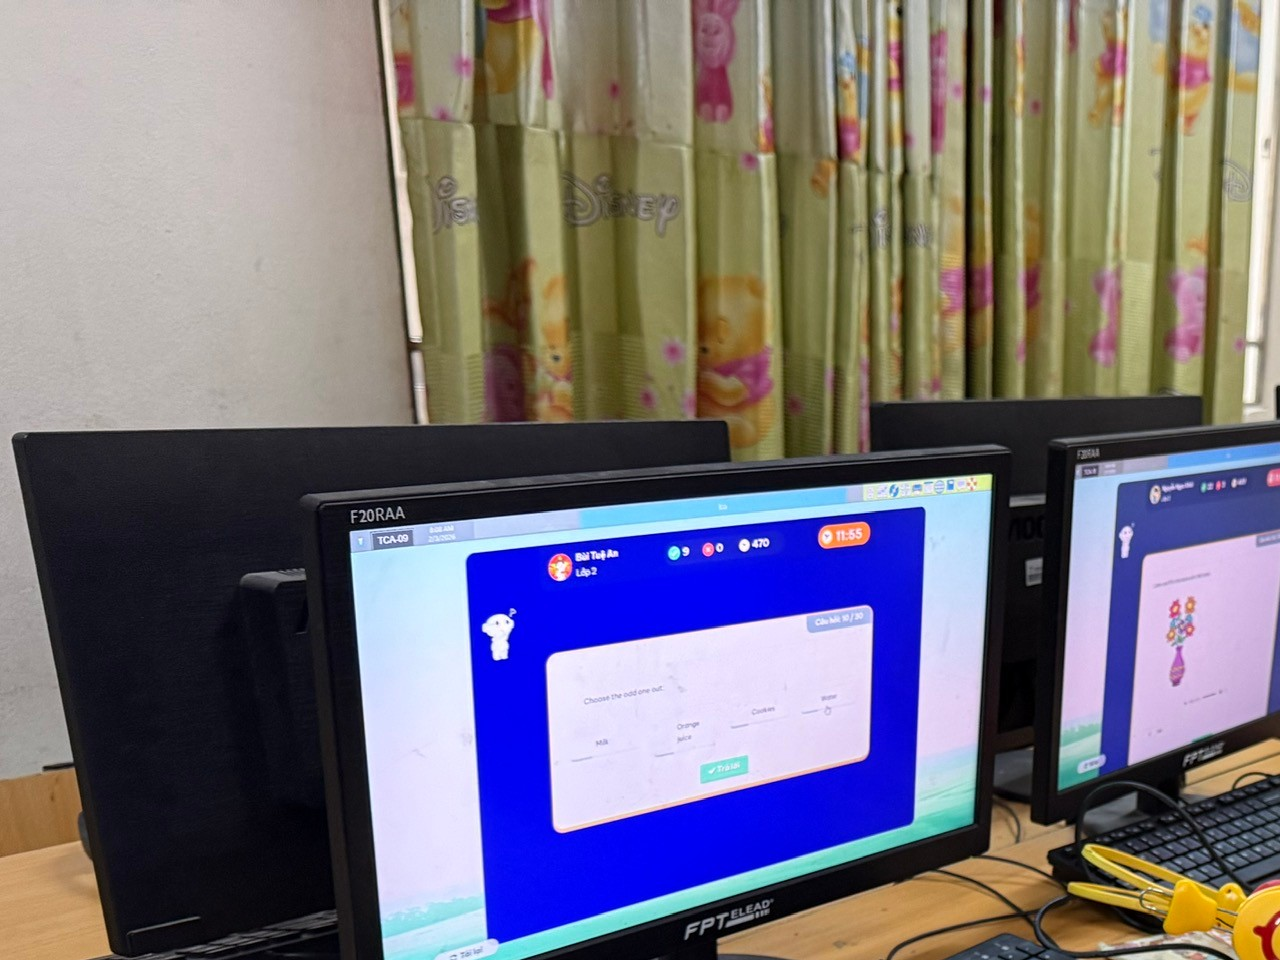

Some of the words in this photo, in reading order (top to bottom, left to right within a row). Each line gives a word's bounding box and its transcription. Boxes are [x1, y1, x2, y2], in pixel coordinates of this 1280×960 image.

[350, 506, 405, 523] F20RAA
[377, 534, 409, 545] TCA-09
[836, 528, 863, 542] 11:55
[715, 542, 724, 552] 0
[752, 538, 770, 548] 470
[606, 549, 619, 558] An
[682, 547, 690, 556] 9
[590, 566, 598, 576] 2
[584, 696, 610, 705] Choose
[623, 689, 637, 698] odd
[752, 706, 775, 716] Cookies
[677, 720, 700, 731] Orange
[684, 911, 730, 940] FPT
[730, 900, 772, 920] ELEAD
